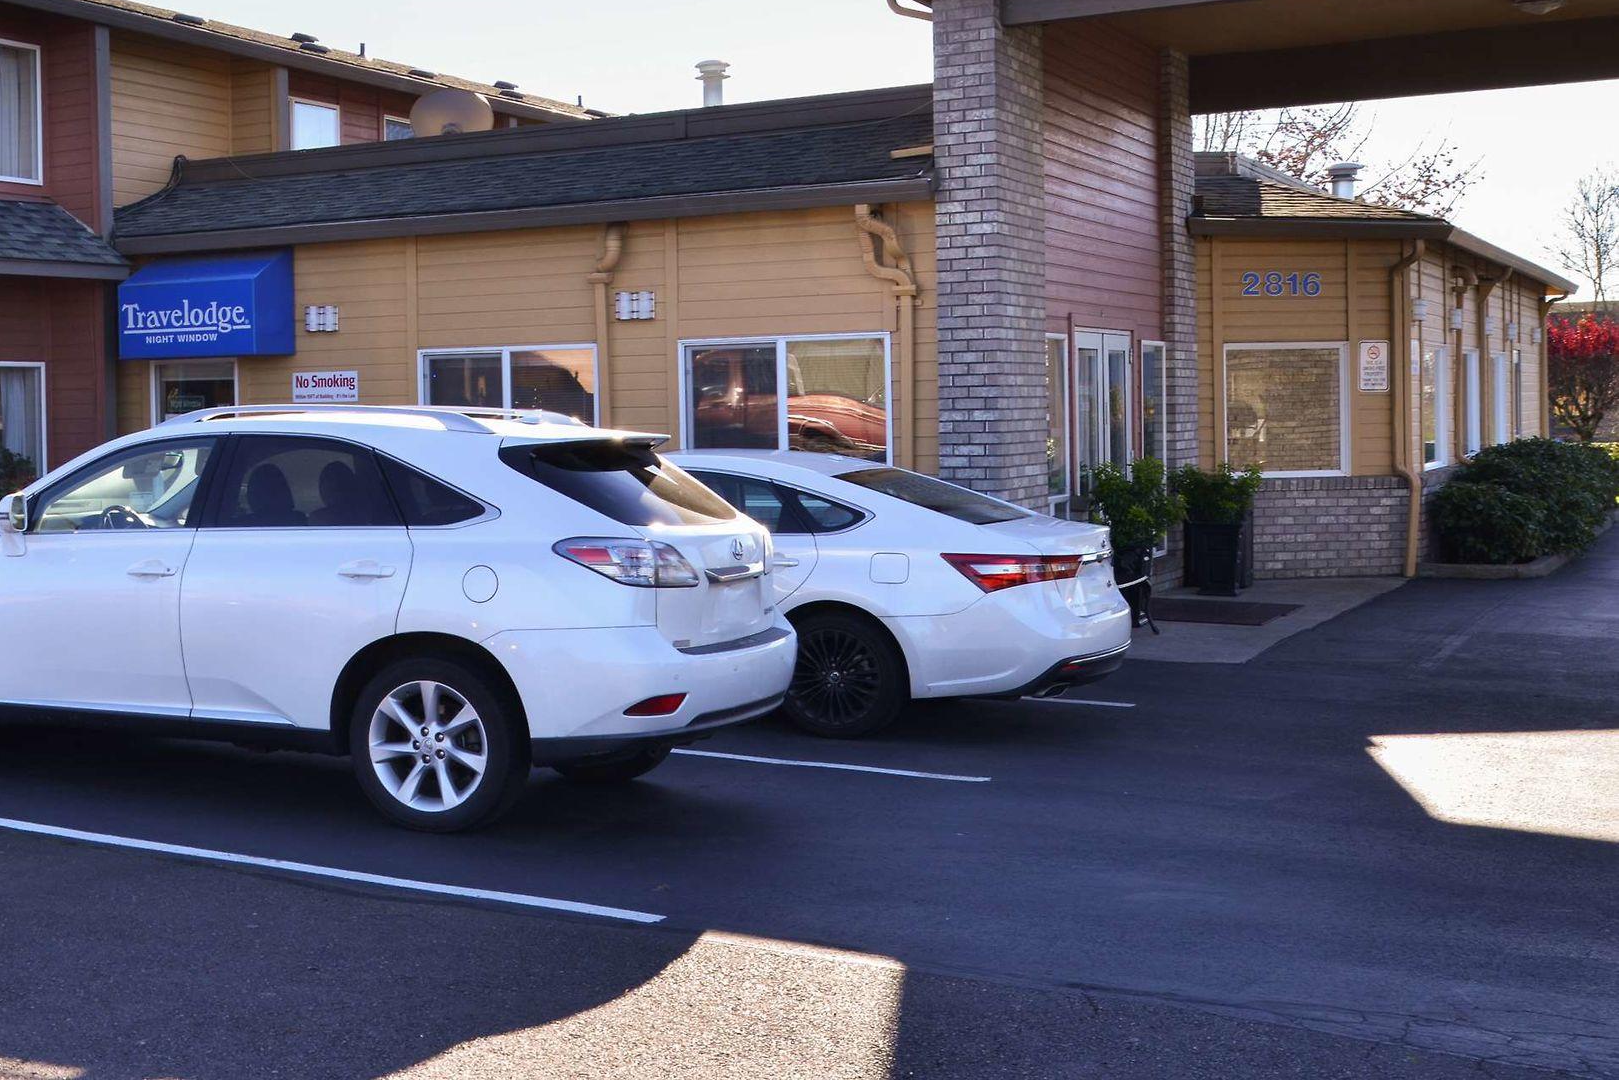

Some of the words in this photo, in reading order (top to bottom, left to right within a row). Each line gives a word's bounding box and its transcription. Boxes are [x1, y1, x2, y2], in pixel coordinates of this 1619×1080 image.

[1241, 271, 1322, 297] 2816
[145, 335, 174, 344] NIGHT
[177, 333, 218, 343] WINDOW
[295, 375, 309, 388] No
[312, 374, 356, 390] Smoking
